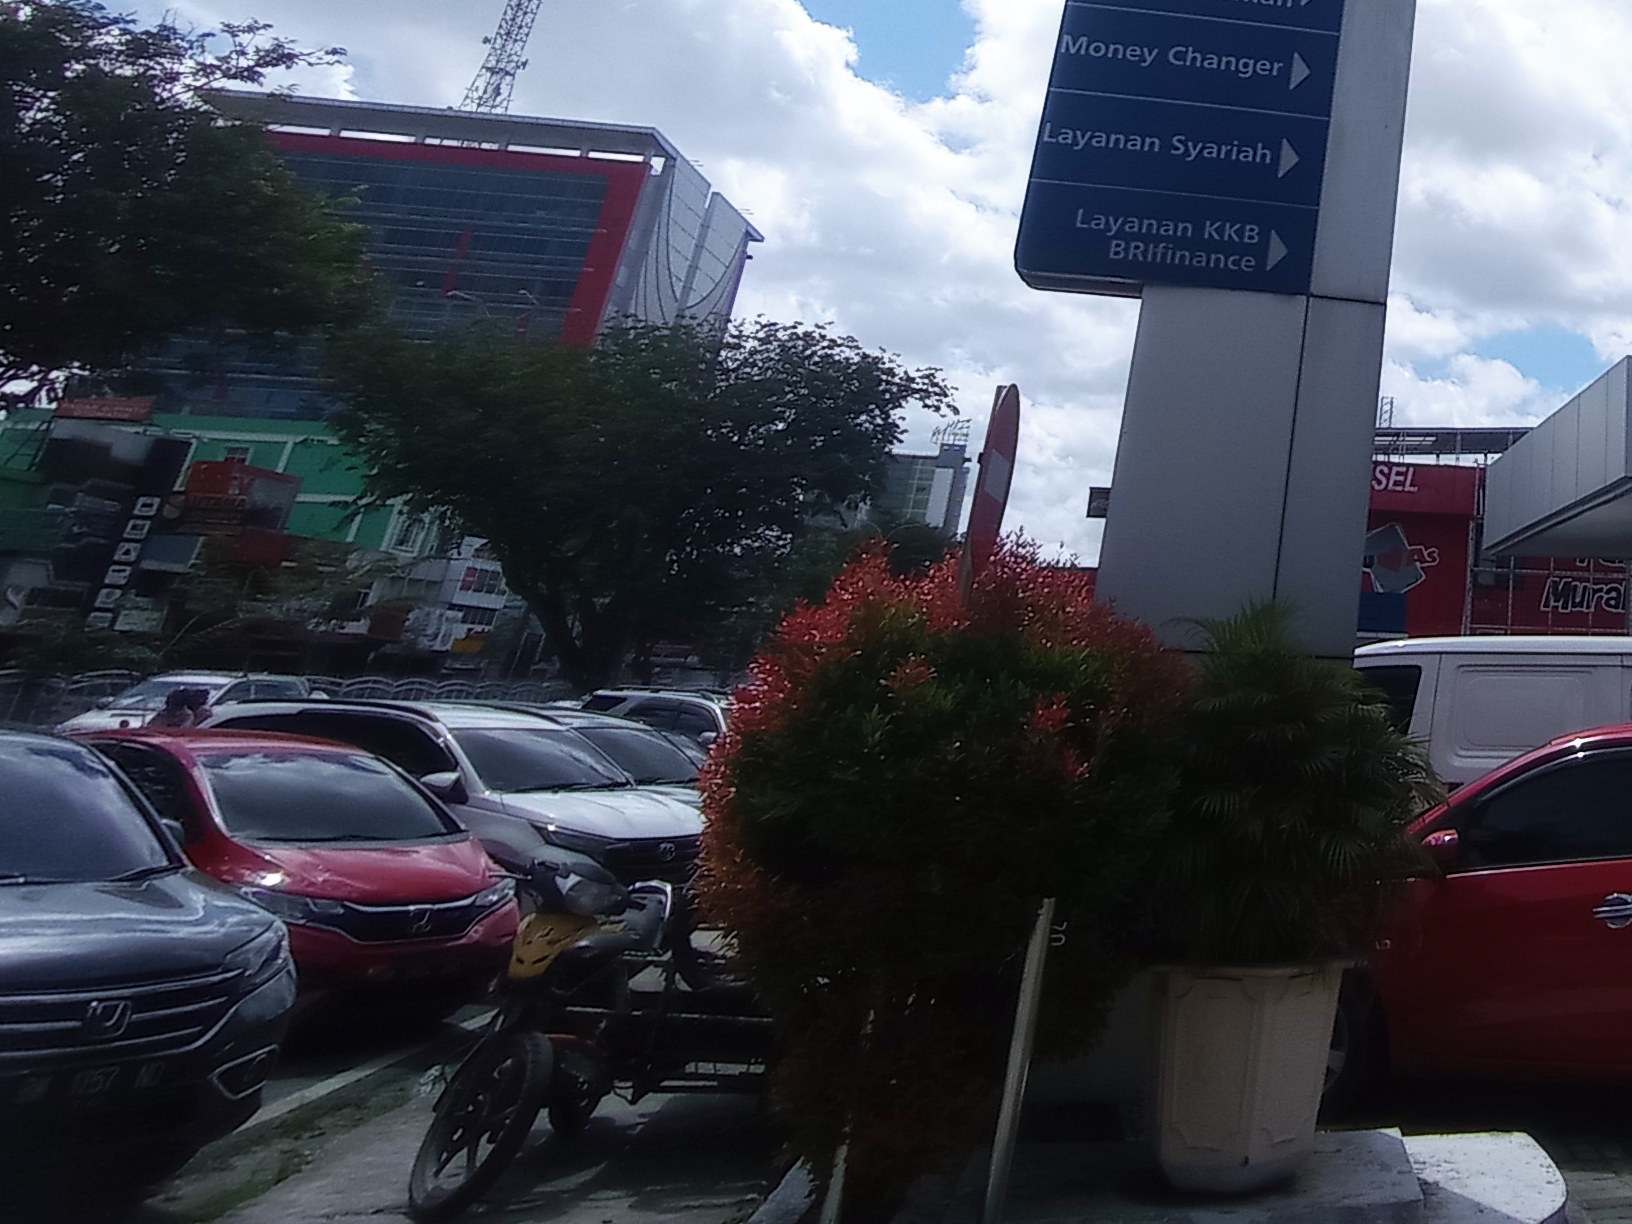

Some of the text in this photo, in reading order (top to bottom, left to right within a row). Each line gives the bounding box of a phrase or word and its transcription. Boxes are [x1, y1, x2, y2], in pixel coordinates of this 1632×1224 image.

[1060, 33, 1283, 78] Money Changer
[1043, 121, 1273, 164] Layanan Syariah
[1075, 208, 1260, 244] Layanan KKB
[1108, 239, 1256, 271] BRIfinance
